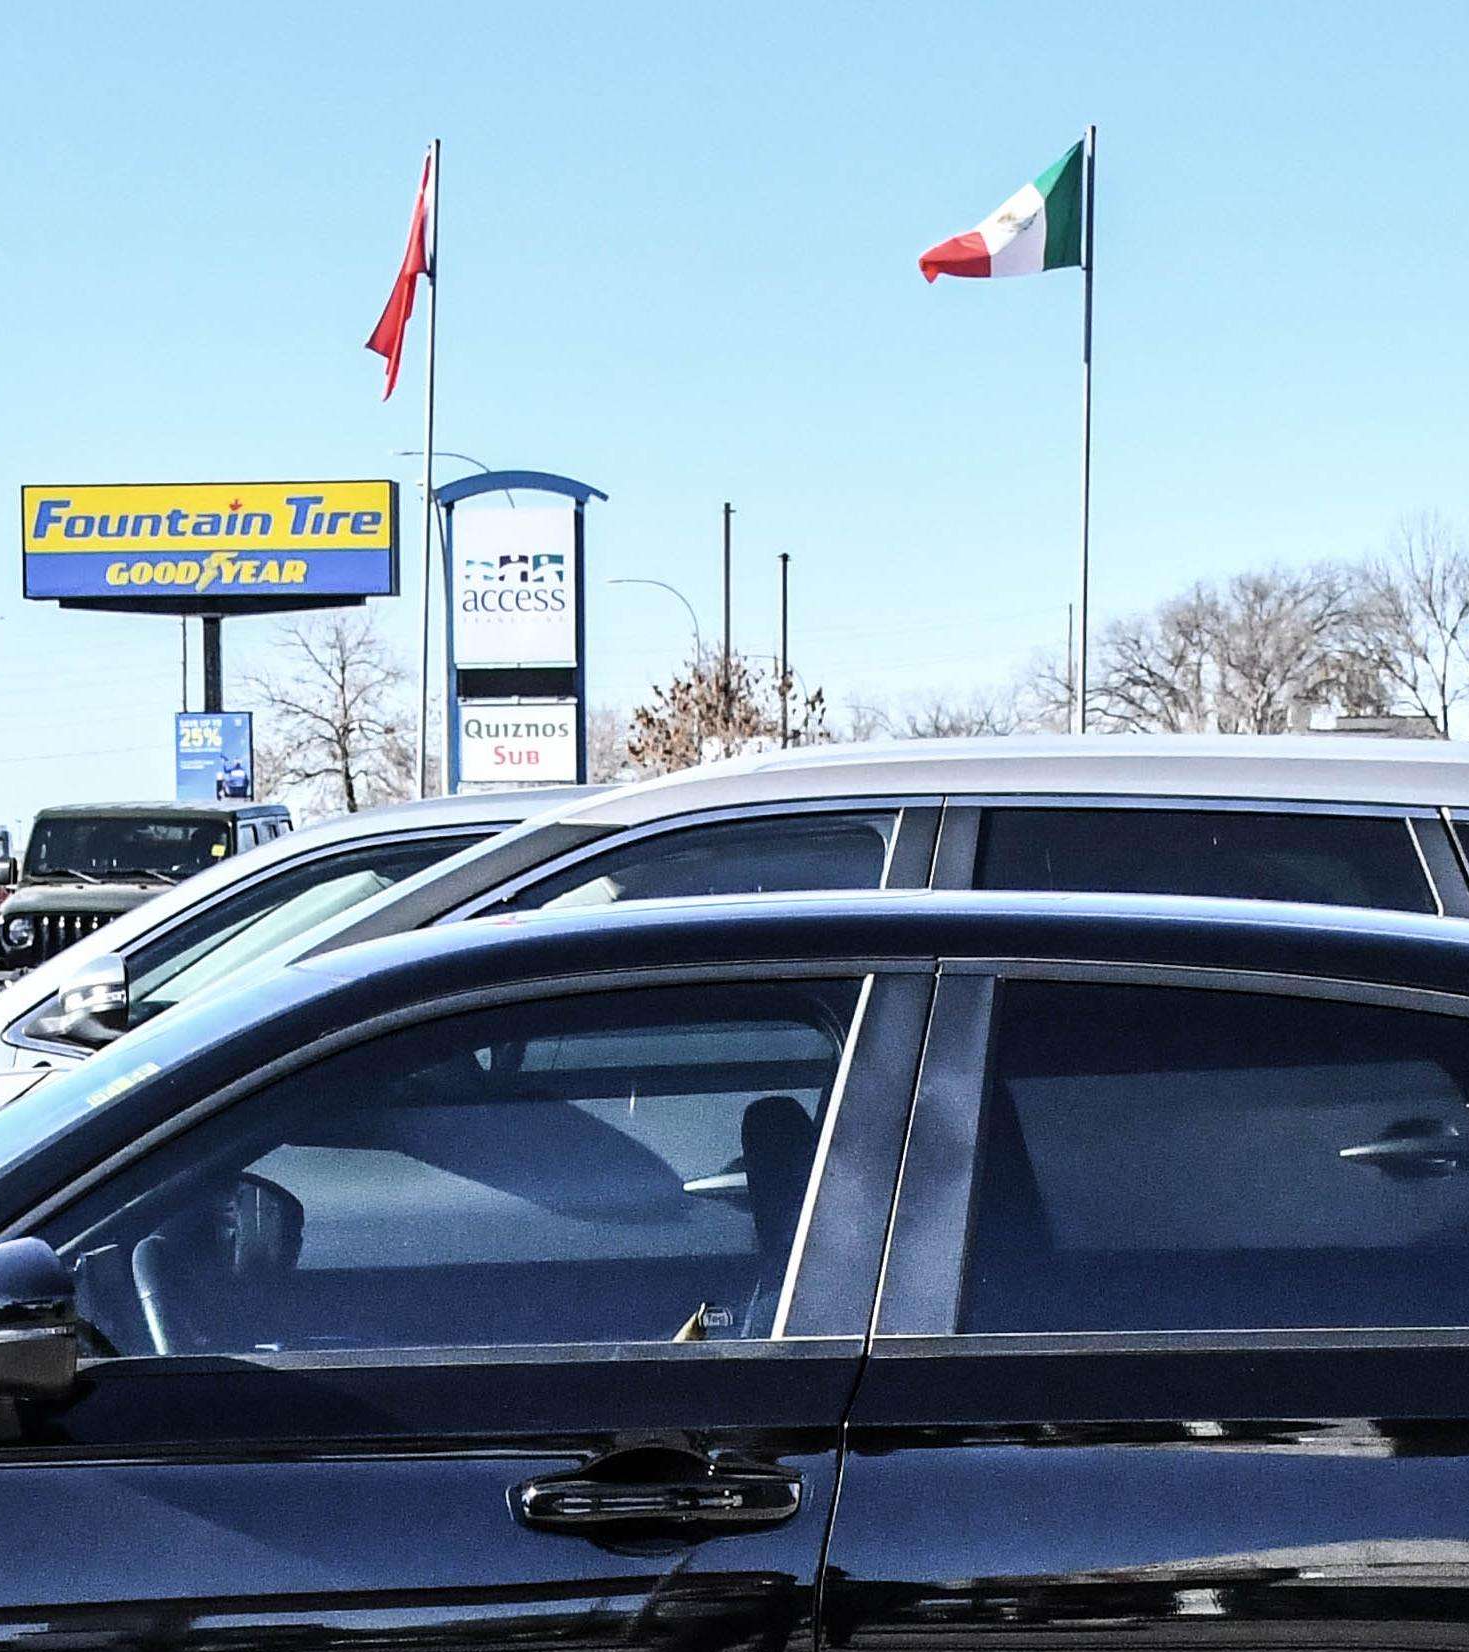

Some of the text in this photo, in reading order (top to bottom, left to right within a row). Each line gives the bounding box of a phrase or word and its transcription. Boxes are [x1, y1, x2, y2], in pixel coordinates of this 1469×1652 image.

[32, 496, 383, 538] Fountain Tire
[105, 557, 308, 588] GOODYEAR
[462, 588, 565, 612] access
[179, 727, 223, 748] 25%
[464, 719, 569, 739] Quiznos
